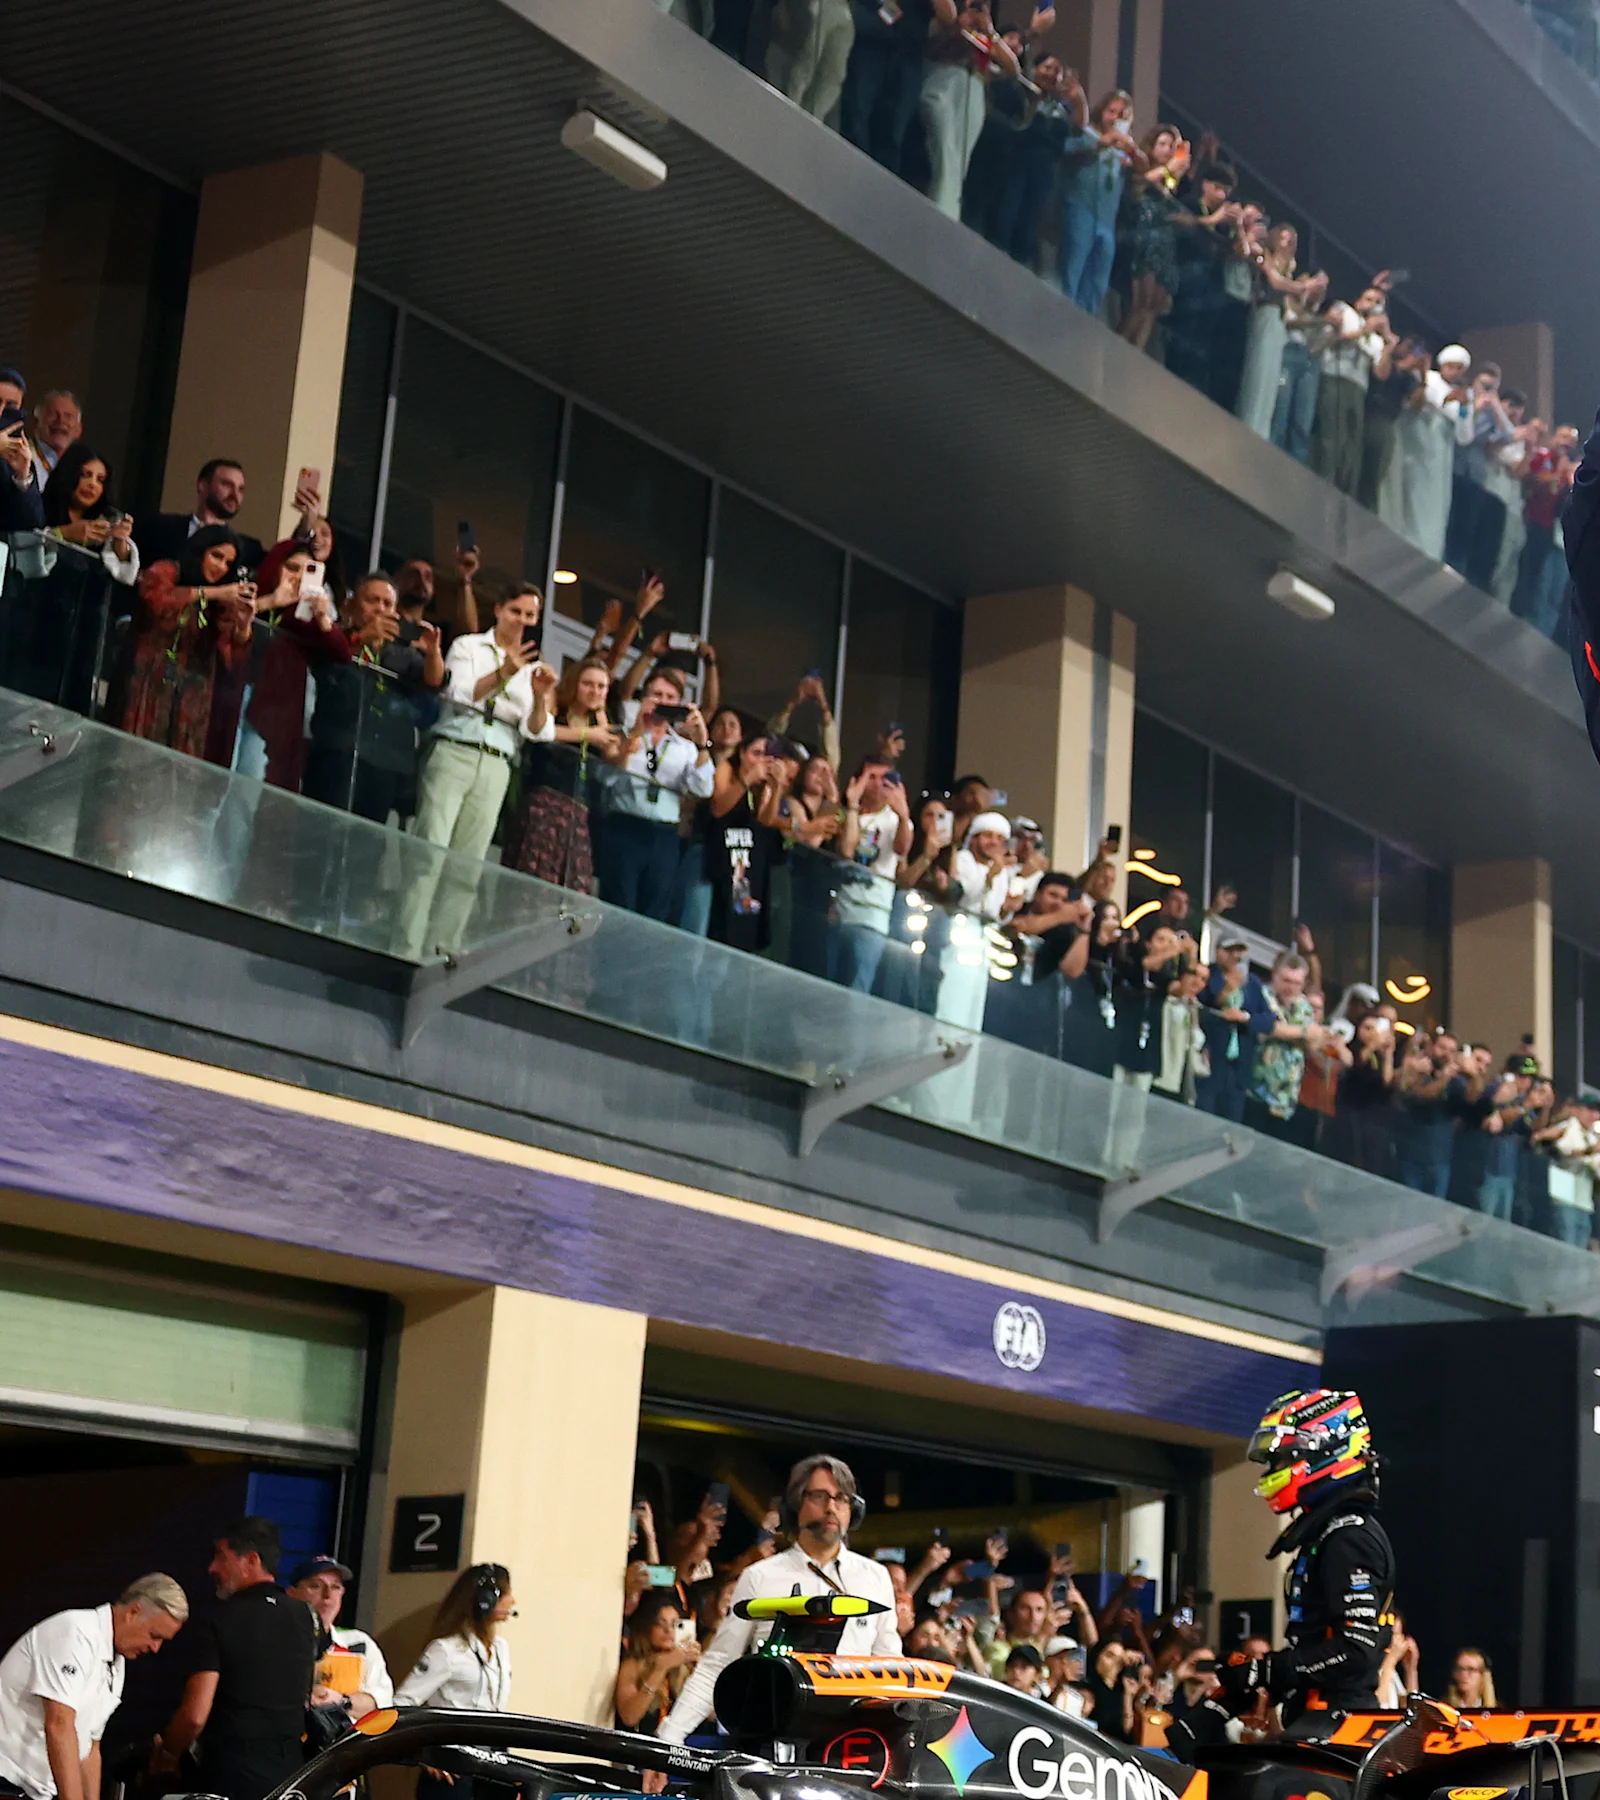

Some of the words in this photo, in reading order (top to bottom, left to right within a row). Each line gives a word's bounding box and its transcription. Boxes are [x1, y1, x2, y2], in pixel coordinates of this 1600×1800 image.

[414, 1513, 441, 1551] 2
[669, 1746, 690, 1757] IRON
[667, 1756, 711, 1772] MOUNTAIN
